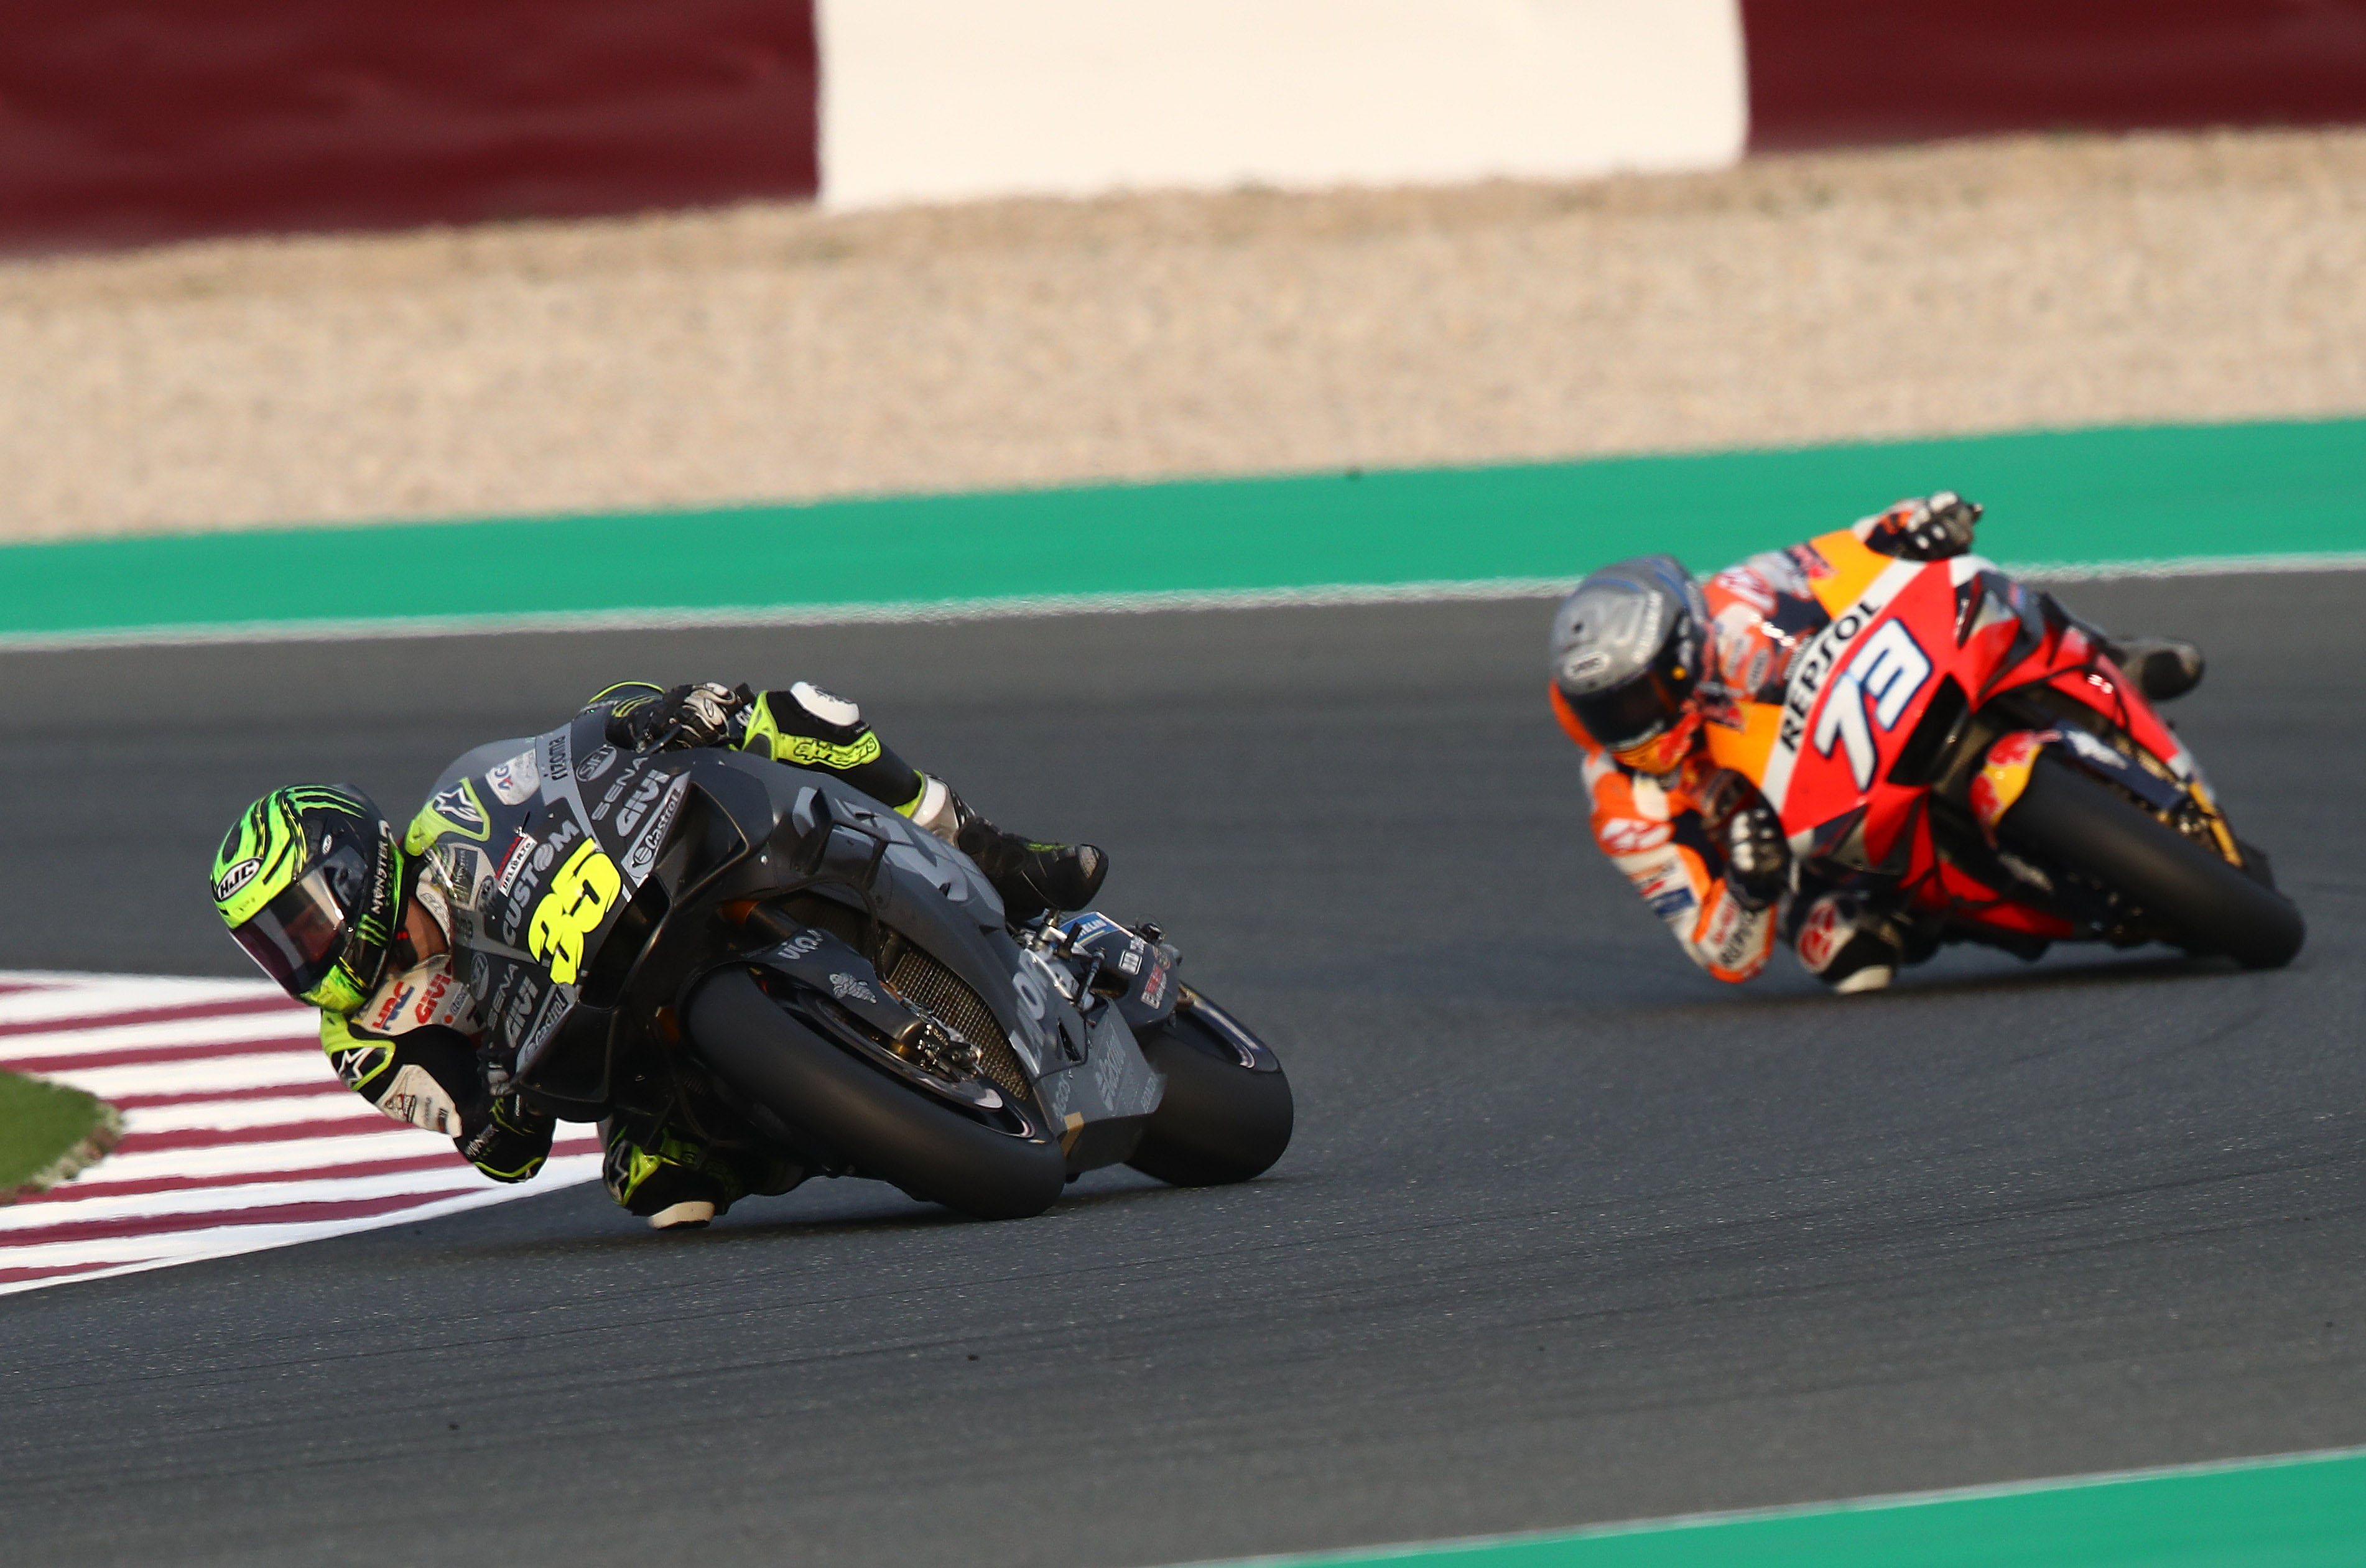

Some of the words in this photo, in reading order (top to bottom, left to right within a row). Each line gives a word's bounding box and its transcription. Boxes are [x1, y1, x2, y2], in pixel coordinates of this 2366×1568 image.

[1781, 602, 1881, 751] REPSOL
[1812, 617, 1934, 793] 73
[592, 756, 649, 820] SENA
[616, 769, 670, 837] GIVI
[645, 789, 682, 850] Castrol
[220, 861, 254, 899] HJC
[371, 840, 389, 914] MONSTER
[503, 819, 580, 947] CUSTOM
[527, 837, 621, 985] 35
[372, 980, 415, 1031] HRC
[415, 973, 451, 1024] GIVI
[505, 975, 539, 1049] GIVI
